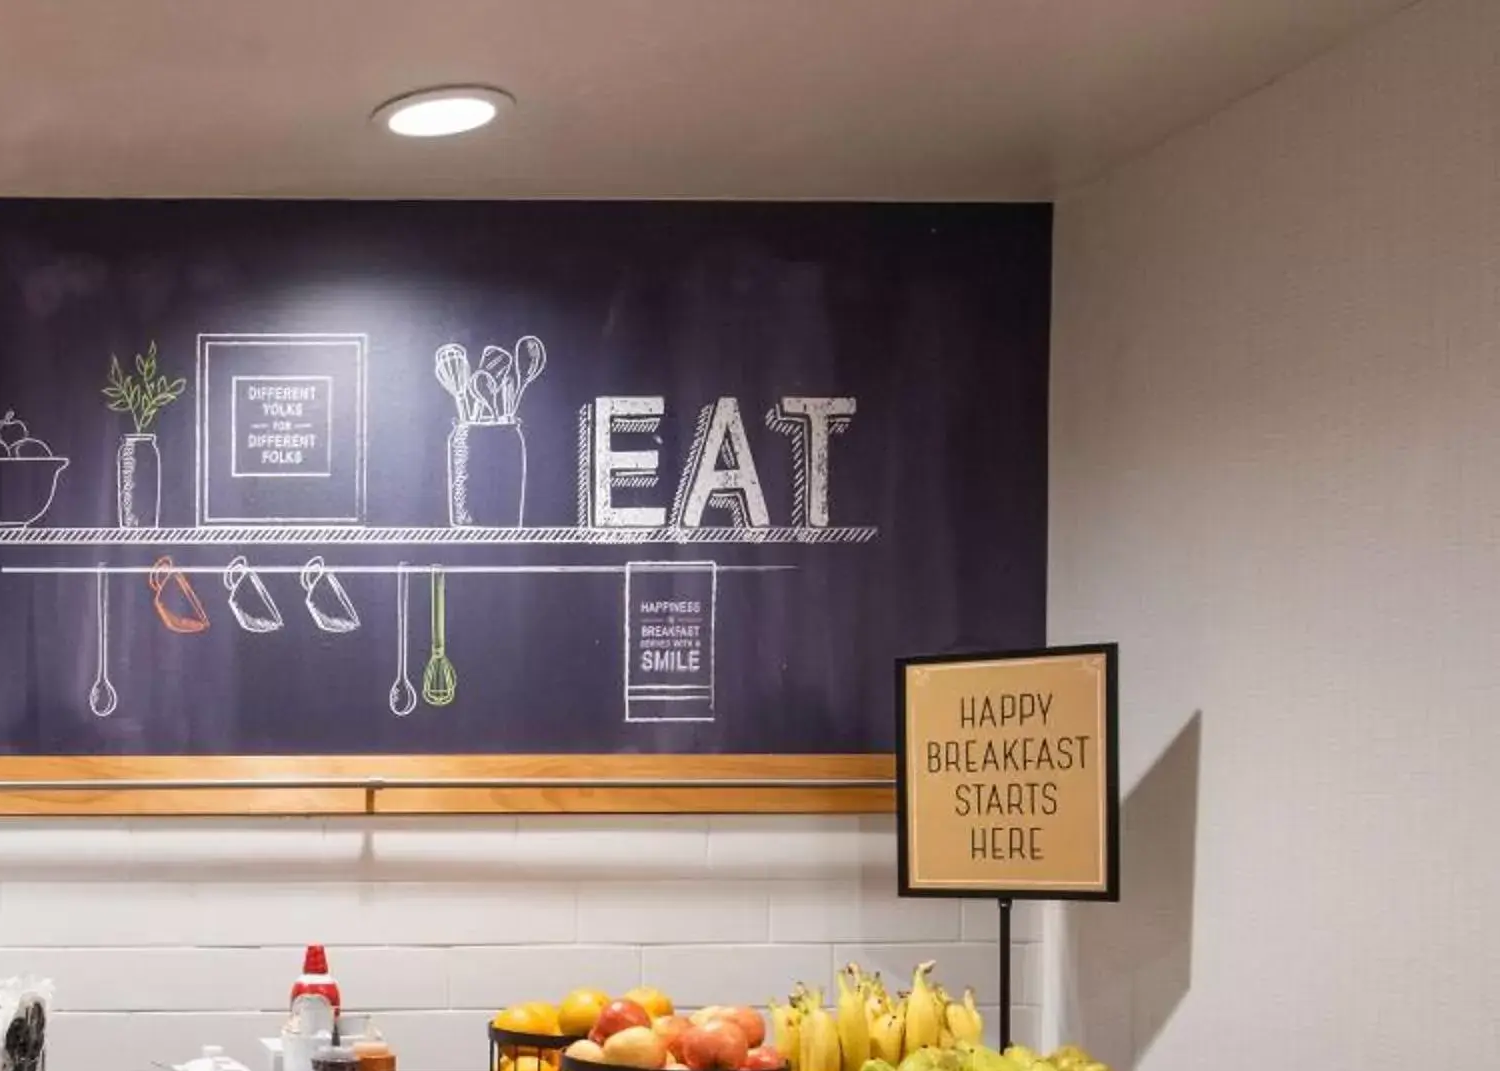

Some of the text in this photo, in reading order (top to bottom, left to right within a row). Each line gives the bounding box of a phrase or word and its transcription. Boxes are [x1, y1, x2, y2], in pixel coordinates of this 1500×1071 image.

[247, 385, 316, 401] DIFFERENT
[262, 402, 303, 417] YOLKS
[247, 433, 316, 449] DIFFERENT
[261, 450, 303, 464] FOLKS
[578, 396, 857, 530] EAT
[640, 601, 701, 613] HAPPINESS
[641, 625, 701, 637] BREAKFAST
[641, 649, 701, 672] SMILE
[960, 692, 1053, 729] HAPPY
[927, 735, 1091, 773] BREAKFAST
[955, 781, 1058, 817] STARTS
[970, 826, 1045, 861] HERE
